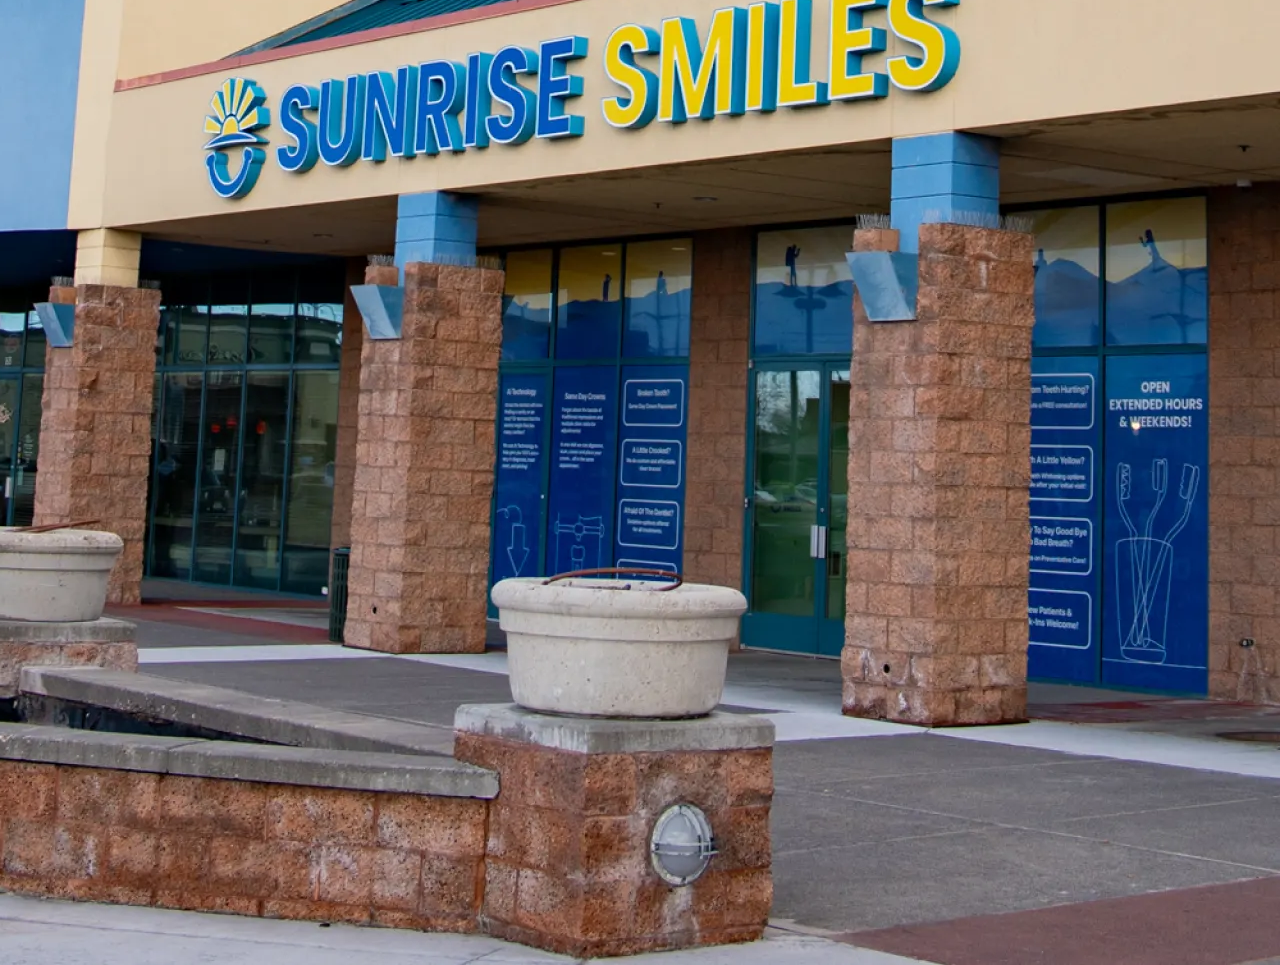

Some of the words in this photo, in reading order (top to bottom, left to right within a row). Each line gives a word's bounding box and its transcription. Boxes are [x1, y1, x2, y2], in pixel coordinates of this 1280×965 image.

[277, 35, 587, 173] SUNRISE
[1141, 381, 1171, 394] OPEN
[1109, 398, 1163, 411] EXTENDED
[1165, 398, 1203, 410] HOURS
[1119, 416, 1128, 428] &
[1129, 416, 1192, 428] WEEKENDS!
